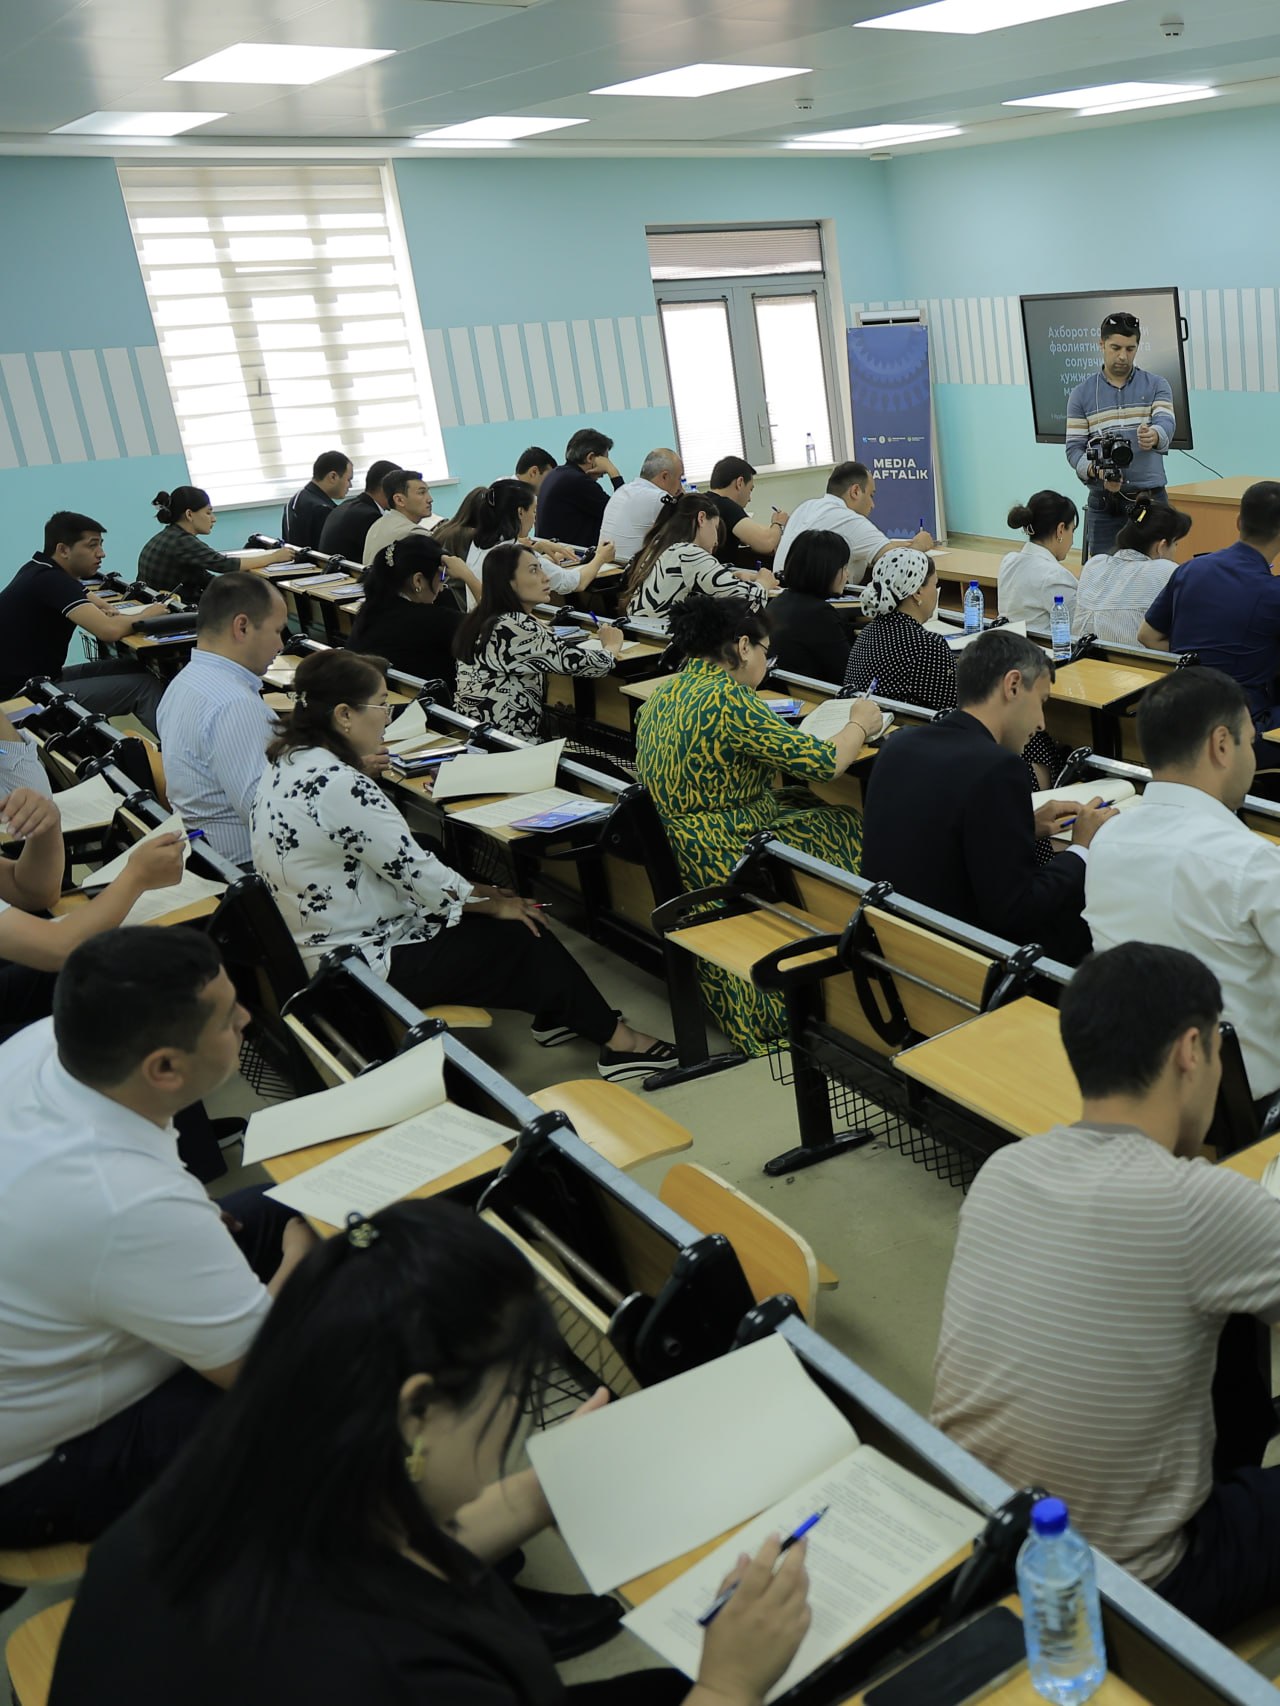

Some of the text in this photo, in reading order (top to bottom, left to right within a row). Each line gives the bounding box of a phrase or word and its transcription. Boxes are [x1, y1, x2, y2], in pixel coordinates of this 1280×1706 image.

[1048, 324, 1088, 340] Ахборот
[873, 458, 916, 468] MEDIA
[868, 469, 929, 479] AFTALIK
